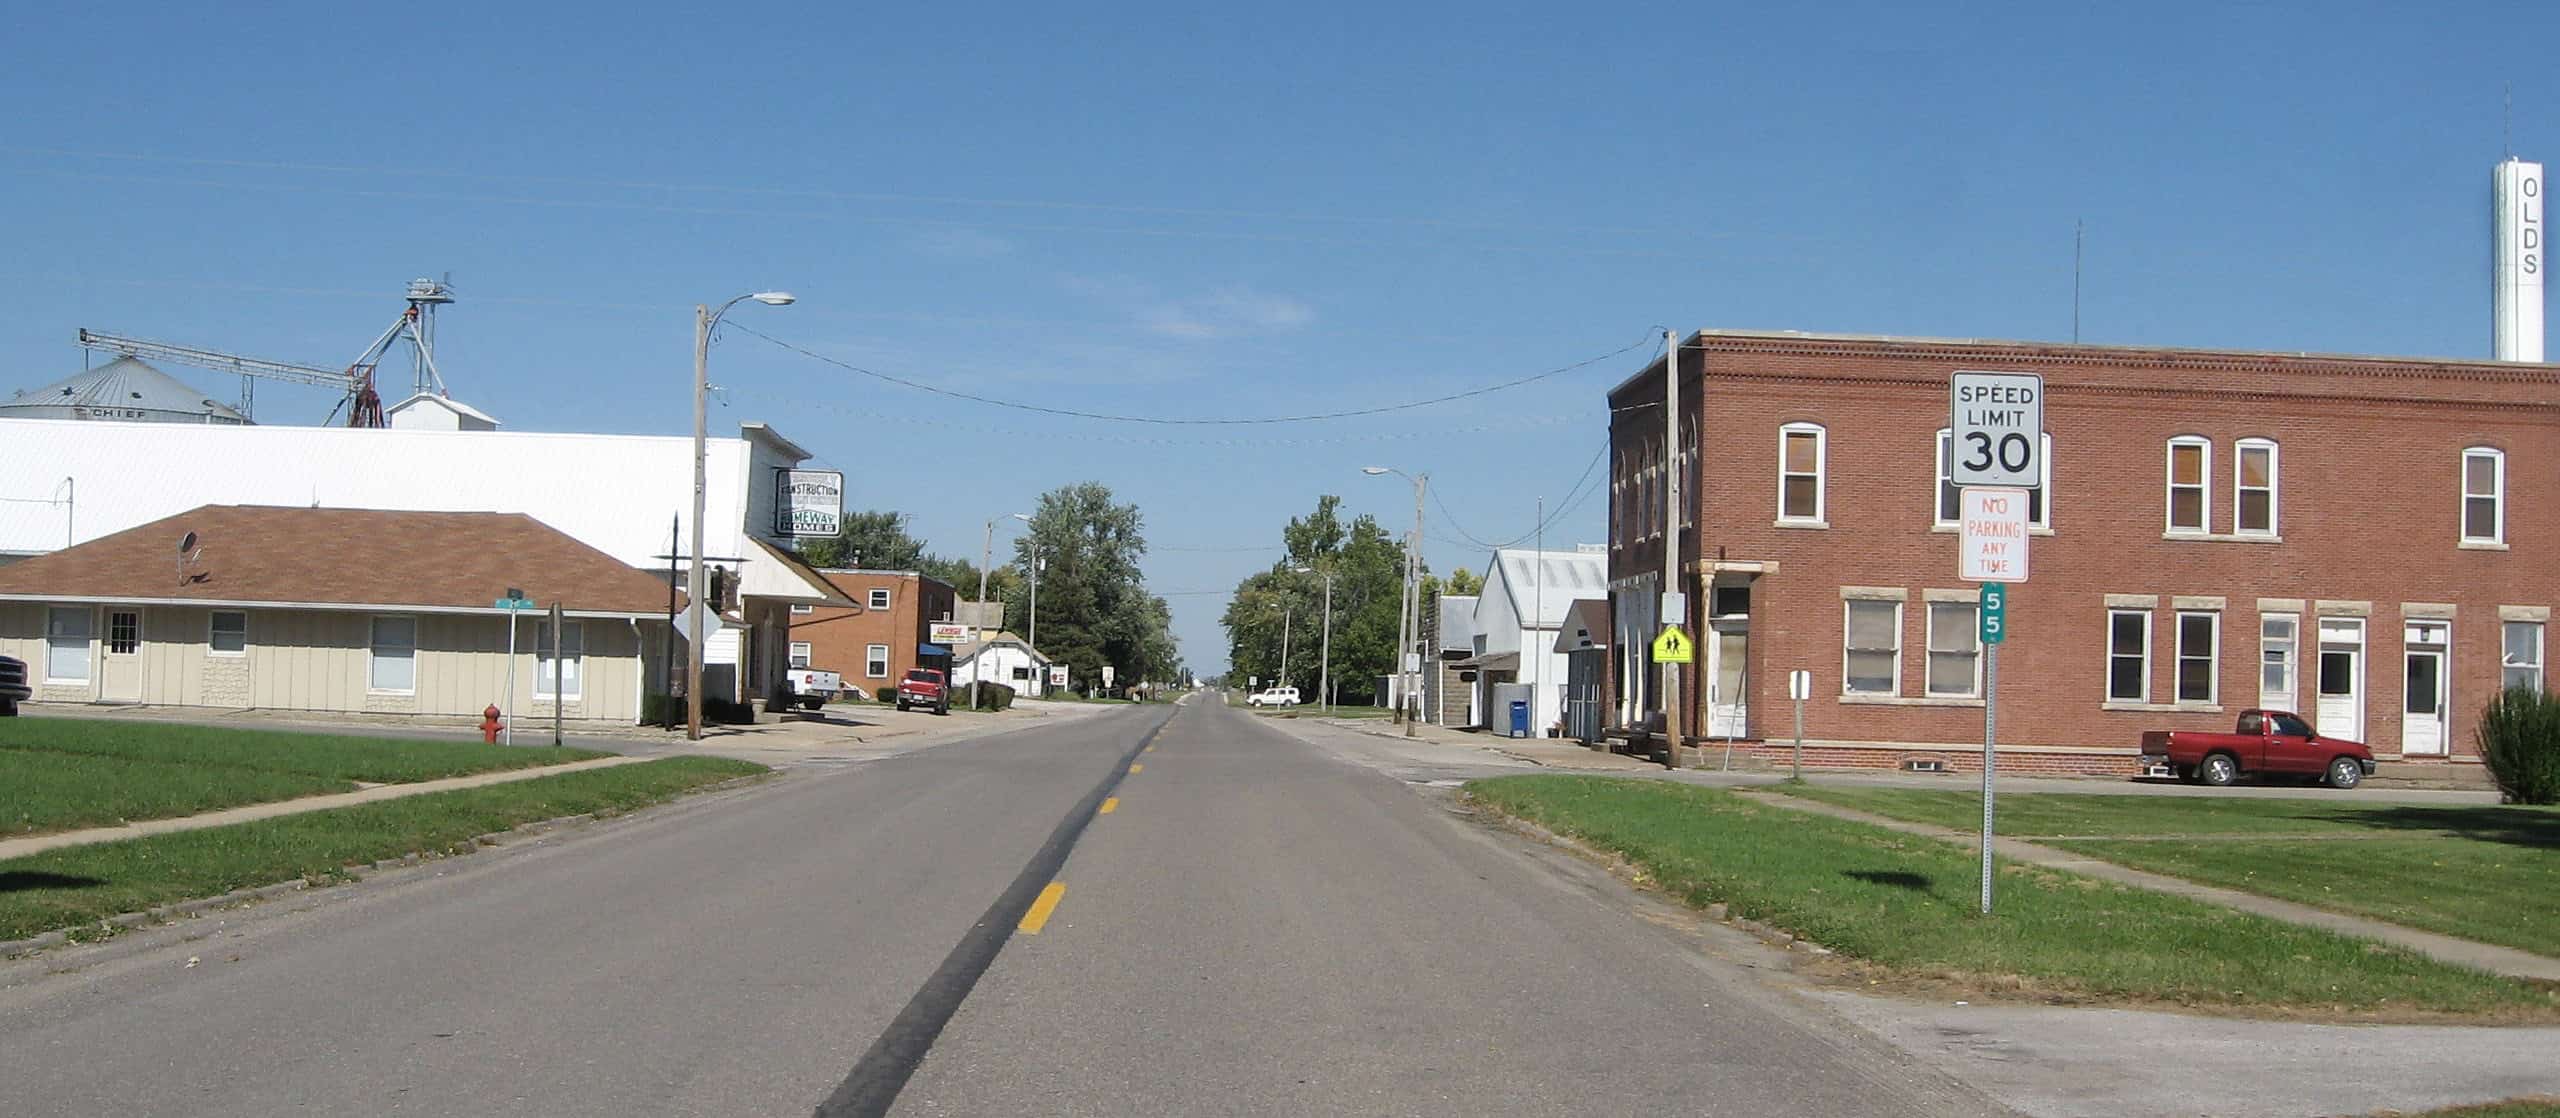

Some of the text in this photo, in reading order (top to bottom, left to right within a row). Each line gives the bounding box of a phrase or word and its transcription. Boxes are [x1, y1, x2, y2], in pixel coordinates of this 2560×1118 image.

[2523, 177, 2538, 274] OLDS
[1960, 386, 2034, 404] SPEED
[93, 409, 145, 418] CHIEF
[1967, 410, 2025, 427] LIMIT
[1963, 431, 2031, 473] 30
[1982, 498, 2008, 514] NO
[1968, 520, 2021, 538] PARKING
[1982, 542, 2007, 555] ANY
[1980, 559, 2009, 573] TIME
